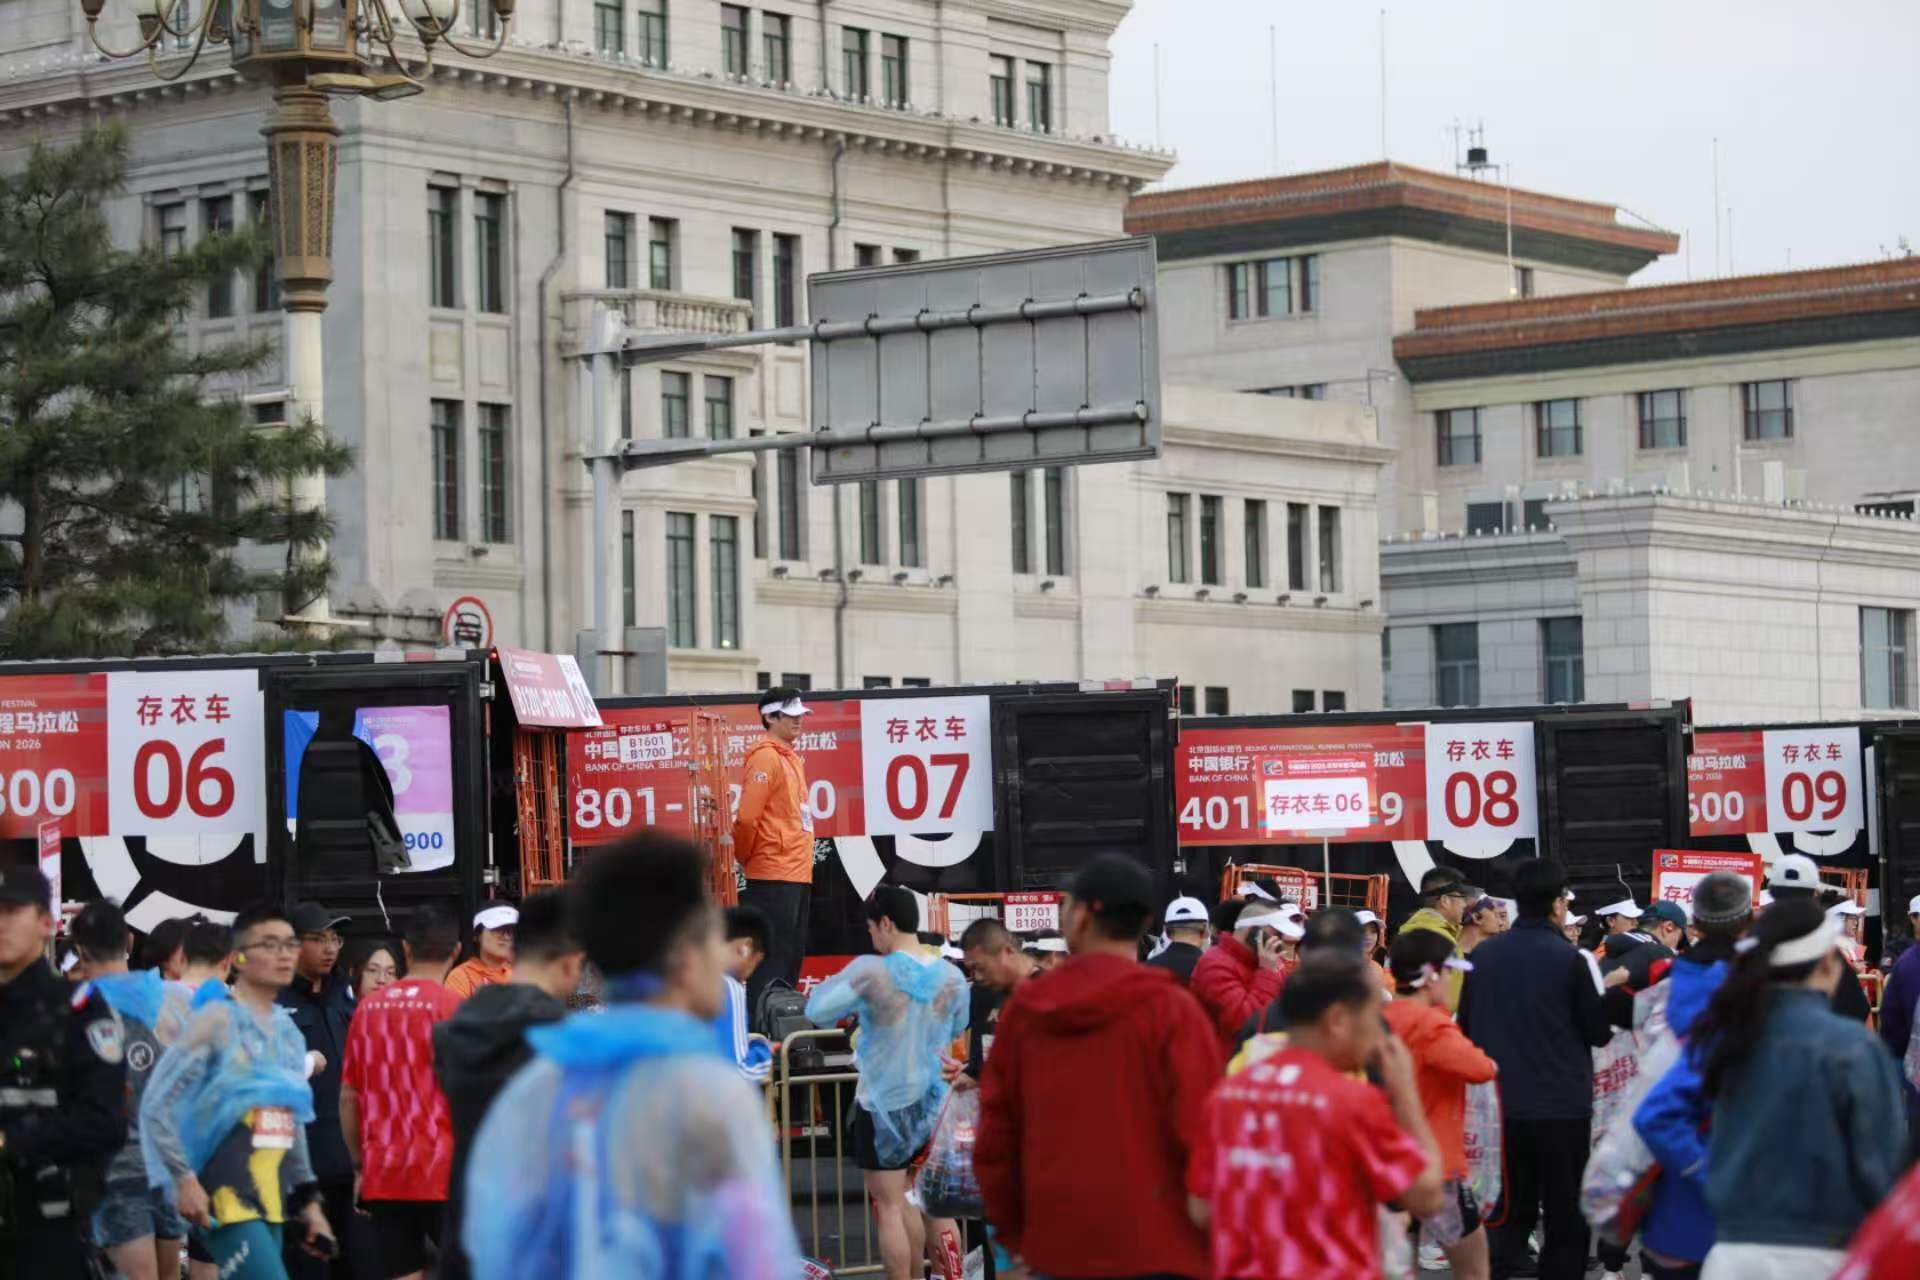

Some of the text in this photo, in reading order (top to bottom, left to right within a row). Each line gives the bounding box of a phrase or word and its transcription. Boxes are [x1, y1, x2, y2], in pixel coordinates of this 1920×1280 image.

[136, 694, 231, 726] 存衣车
[886, 716, 966, 744] 存衣车
[16, 739, 41, 749] 2026
[629, 736, 664, 748] B1601
[1446, 738, 1516, 762] 存衣车
[1782, 742, 1842, 764] 存衣车
[585, 763, 610, 772] BANK
[627, 760, 655, 769] CHINA
[1188, 755, 1249, 772] 中国银行
[1687, 754, 1746, 770] 程马拉松
[133, 737, 235, 819] 06
[886, 753, 970, 820] 07
[1189, 775, 1210, 783] BANK
[1224, 774, 1249, 782] CHINA
[0, 768, 76, 817] 00
[1445, 770, 1519, 828] 08
[1782, 770, 1847, 822] 09
[1270, 793, 1362, 815] 存衣车 06
[1015, 907, 1050, 917] B1701
[1015, 918, 1051, 929] B1800
